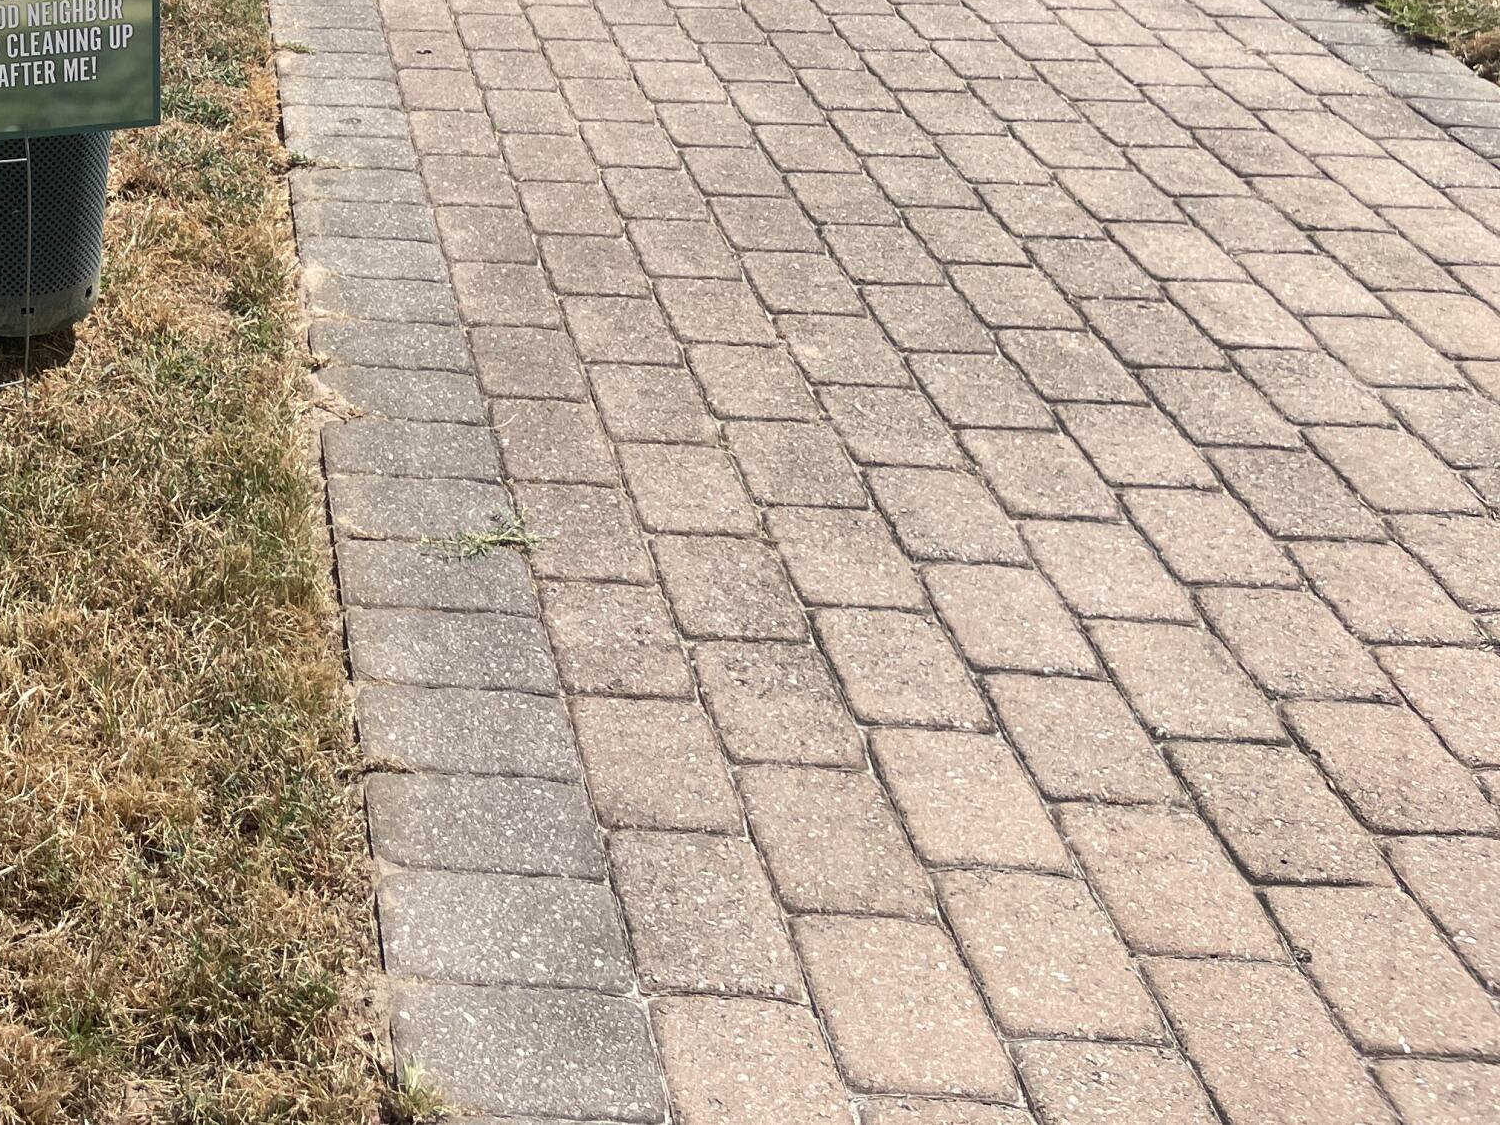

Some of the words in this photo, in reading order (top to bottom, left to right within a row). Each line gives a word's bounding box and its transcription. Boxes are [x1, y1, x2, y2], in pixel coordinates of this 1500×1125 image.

[7, 27, 101, 58] CLEANING
[109, 24, 133, 49] UP
[64, 57, 98, 82] ME!
